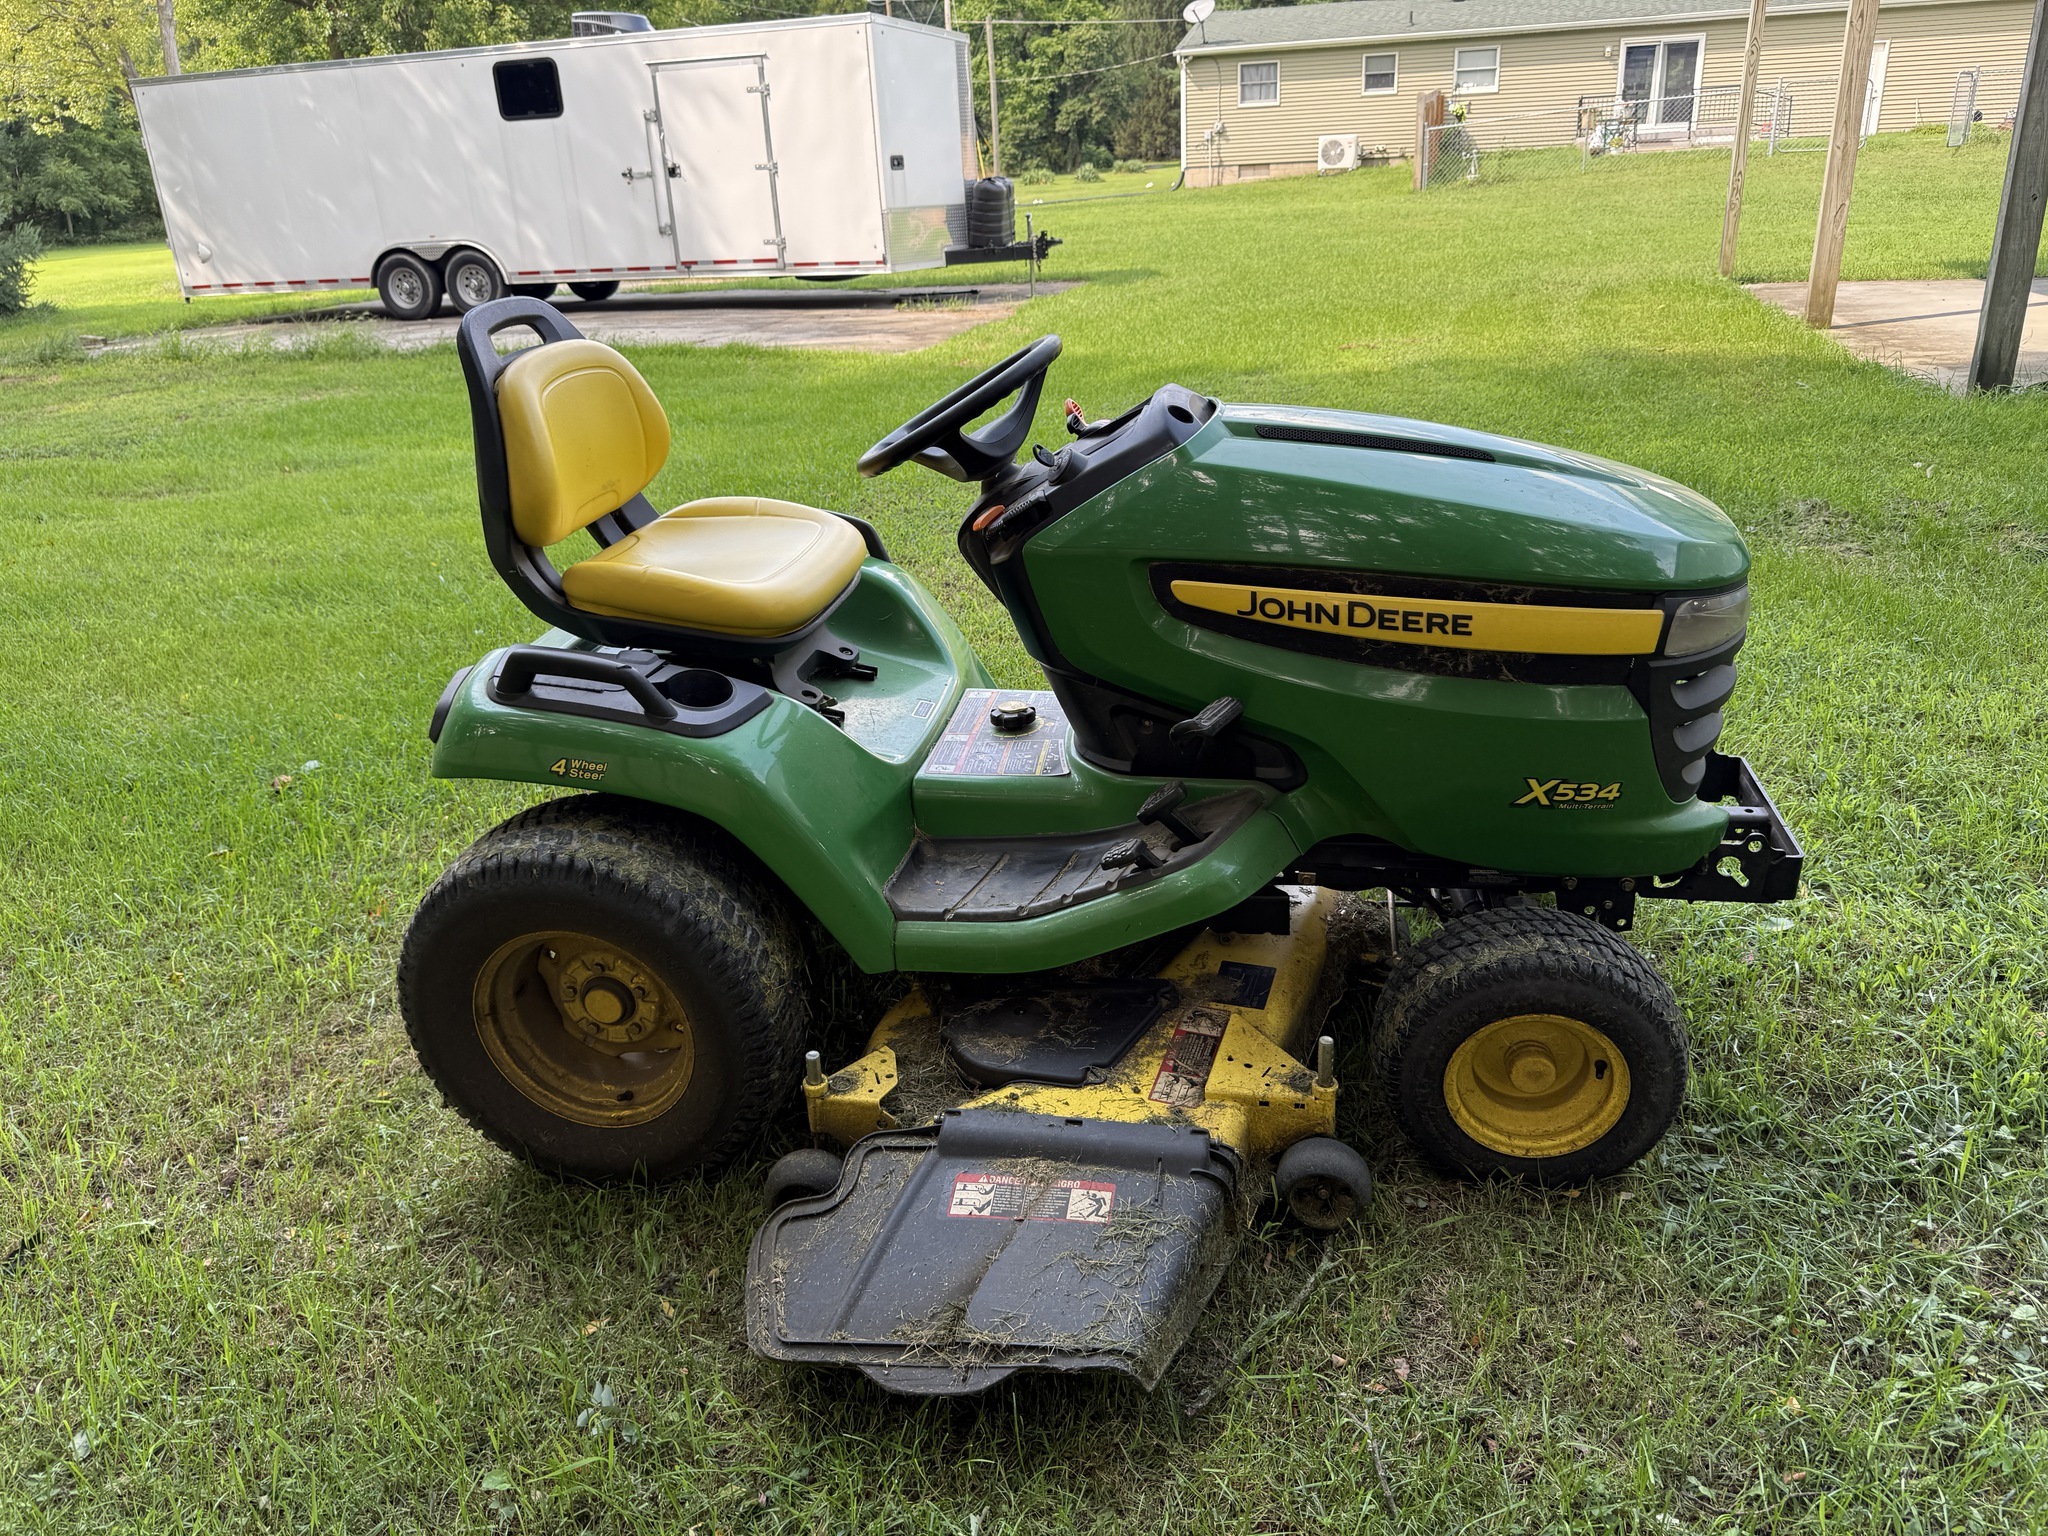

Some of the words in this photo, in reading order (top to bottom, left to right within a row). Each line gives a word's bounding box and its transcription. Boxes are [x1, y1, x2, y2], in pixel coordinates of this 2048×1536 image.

[1237, 591, 1339, 626] JOHN
[1347, 601, 1473, 636] DEERE
[551, 758, 567, 775] 4
[571, 759, 608, 771] Wheel
[569, 768, 605, 780] Steer
[1513, 778, 1621, 806] X534
